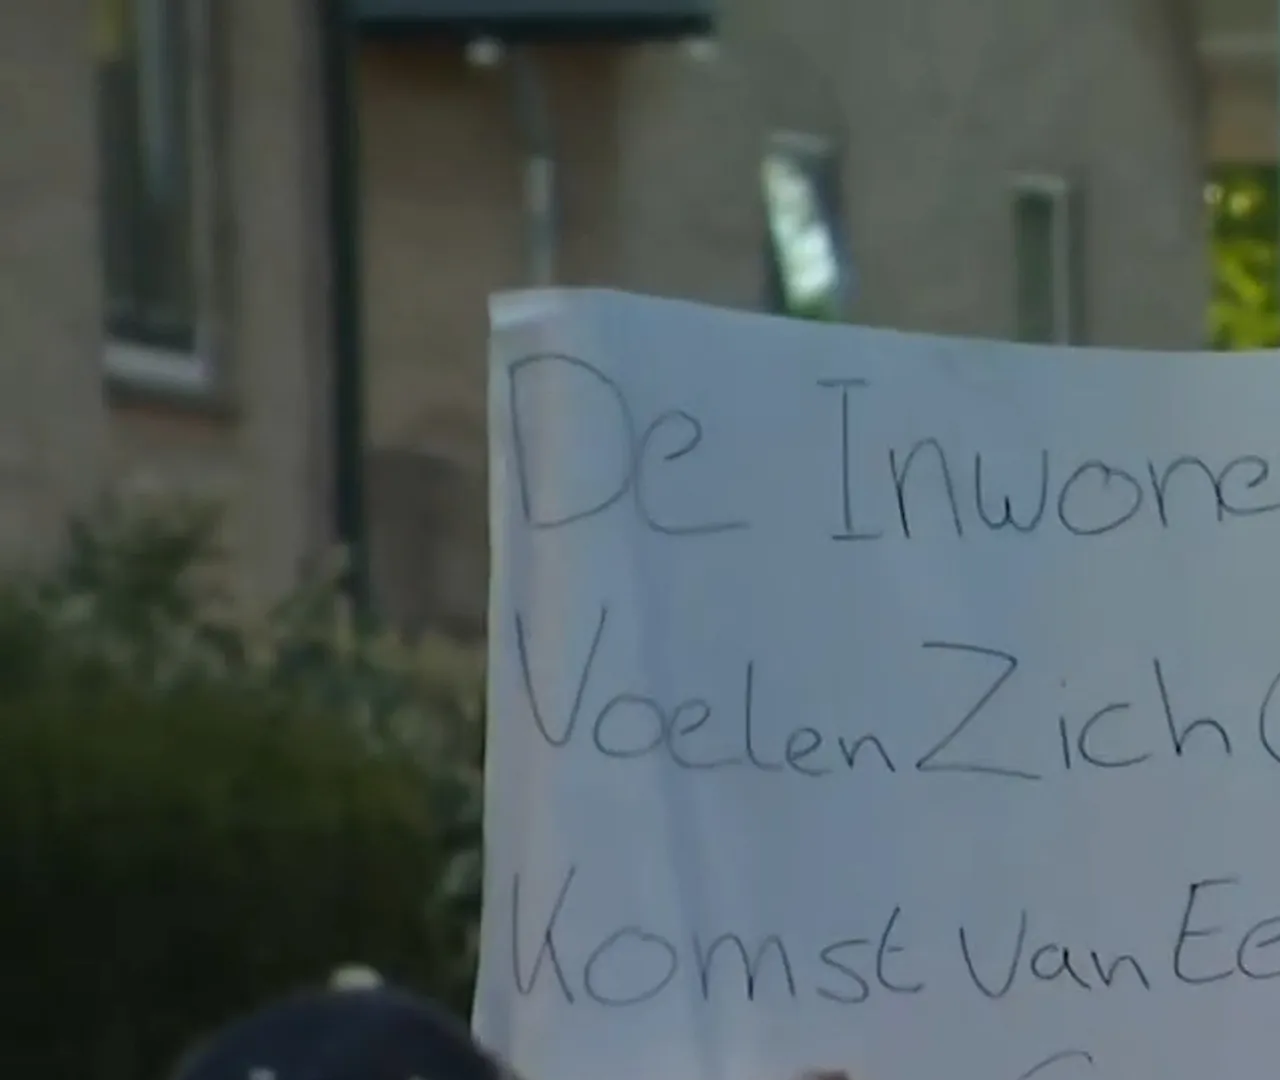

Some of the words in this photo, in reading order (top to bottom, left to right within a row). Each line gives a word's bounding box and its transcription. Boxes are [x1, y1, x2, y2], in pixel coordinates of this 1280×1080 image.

[508, 352, 752, 534] De
[514, 607, 896, 775] Voelen
[915, 640, 1233, 780] Zich
[510, 865, 926, 1004] Komst
